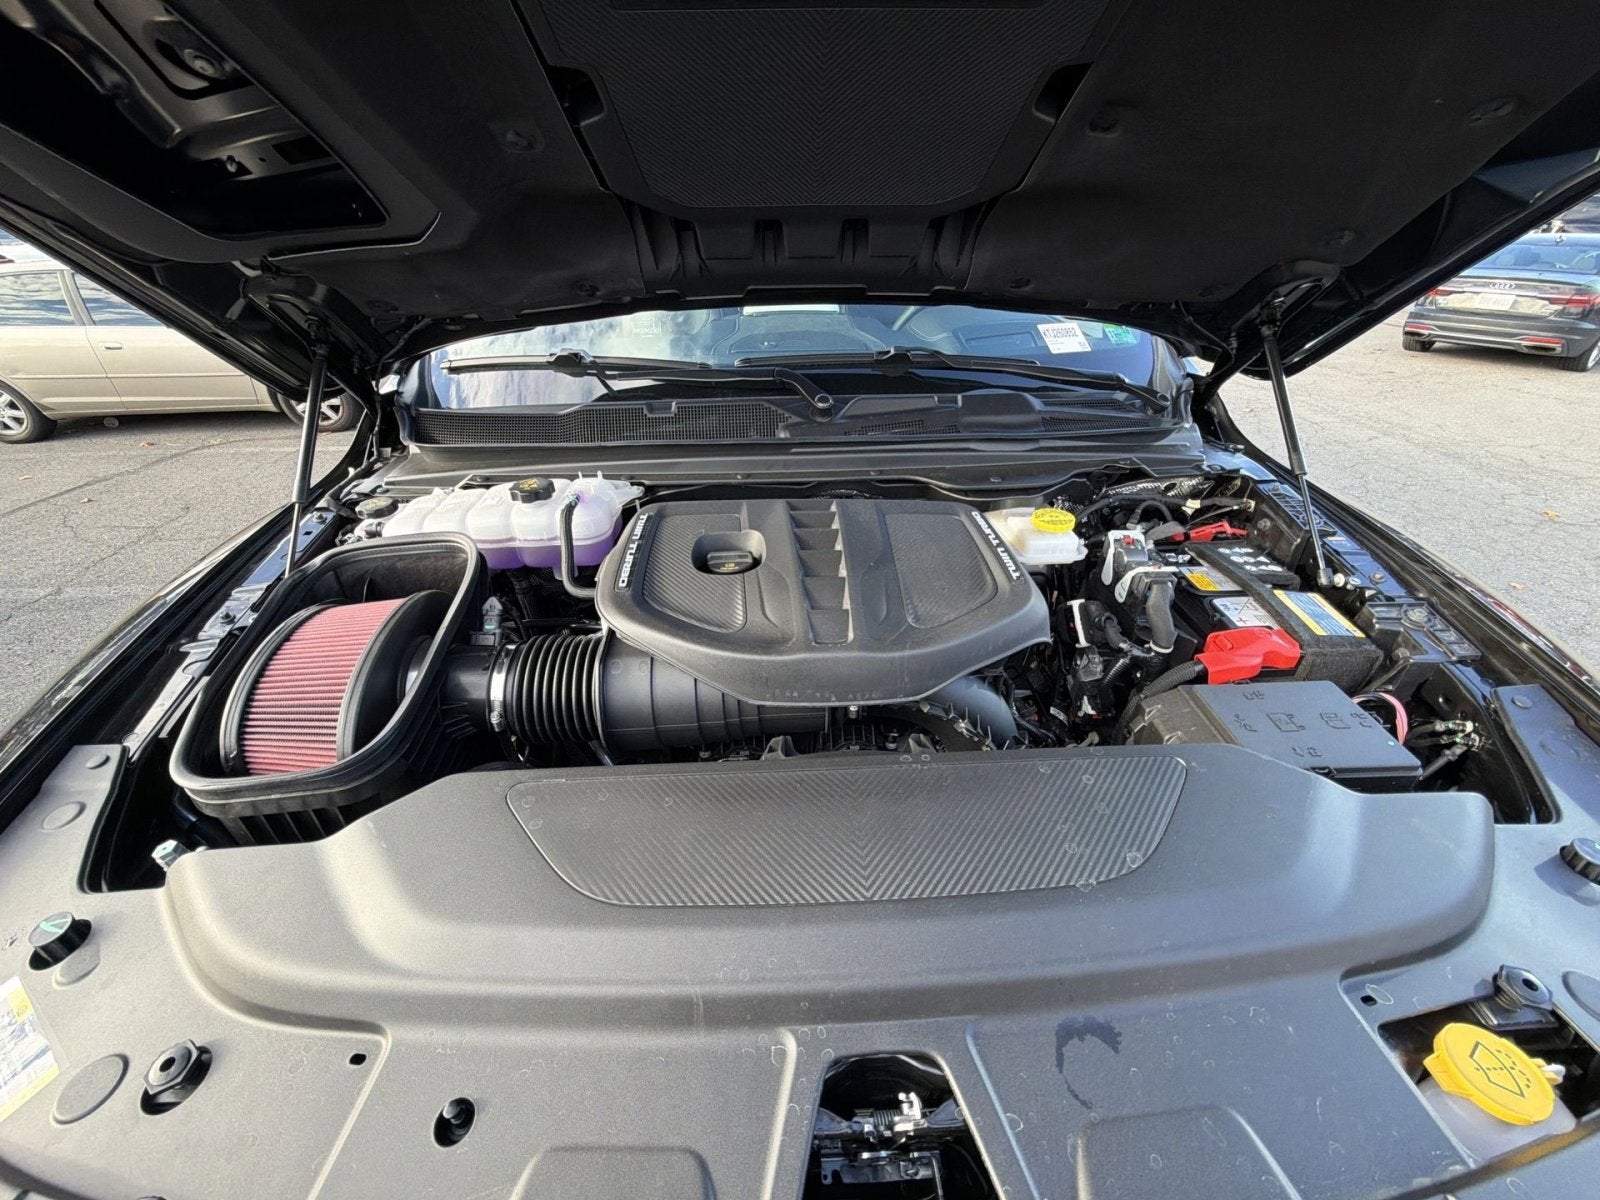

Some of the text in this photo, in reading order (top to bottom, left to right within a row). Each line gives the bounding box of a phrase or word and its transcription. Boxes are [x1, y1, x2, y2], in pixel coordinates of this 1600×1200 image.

[618, 513, 648, 587] TWIN TURBO
[971, 511, 1020, 580] TWIN TURBO
